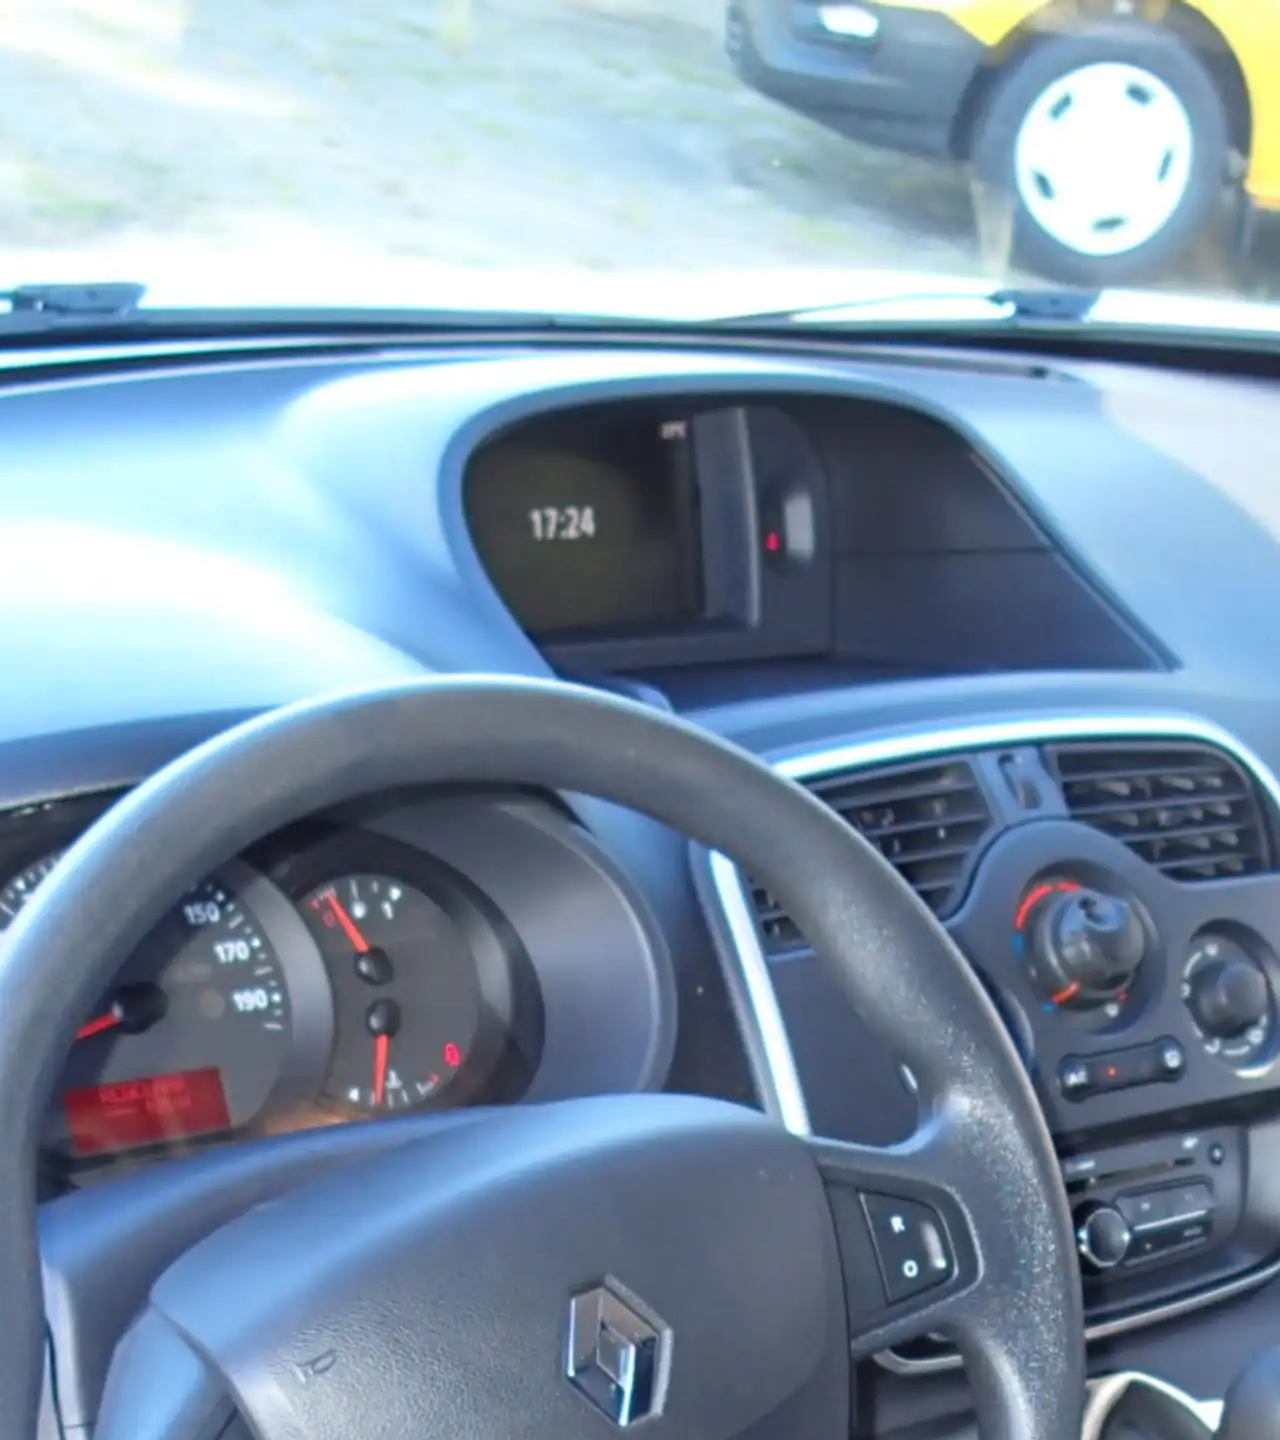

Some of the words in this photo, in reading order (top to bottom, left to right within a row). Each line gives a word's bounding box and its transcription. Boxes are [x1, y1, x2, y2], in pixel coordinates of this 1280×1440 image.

[530, 506, 595, 540] 17:24
[184, 901, 220, 926] 150
[214, 938, 250, 963] 170
[233, 988, 269, 1012] 190
[890, 1215, 906, 1234] R
